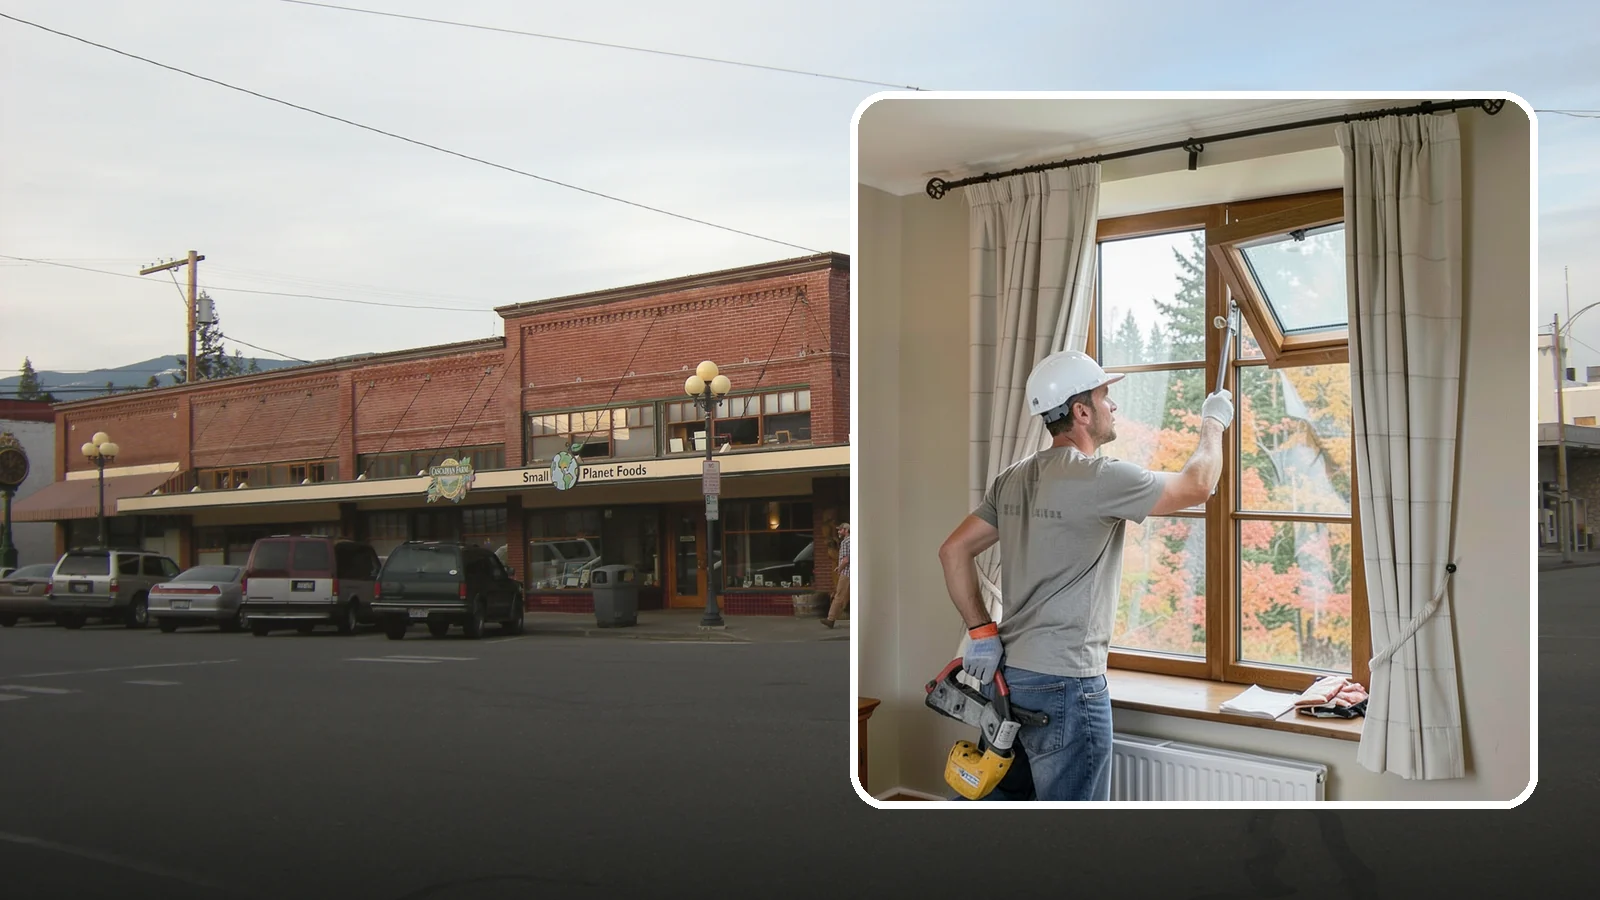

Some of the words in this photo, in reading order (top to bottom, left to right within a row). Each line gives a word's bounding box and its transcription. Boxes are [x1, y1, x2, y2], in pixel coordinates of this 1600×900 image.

[523, 470, 549, 483] Small
[582, 467, 614, 479] Planet
[616, 464, 647, 477] Foods
